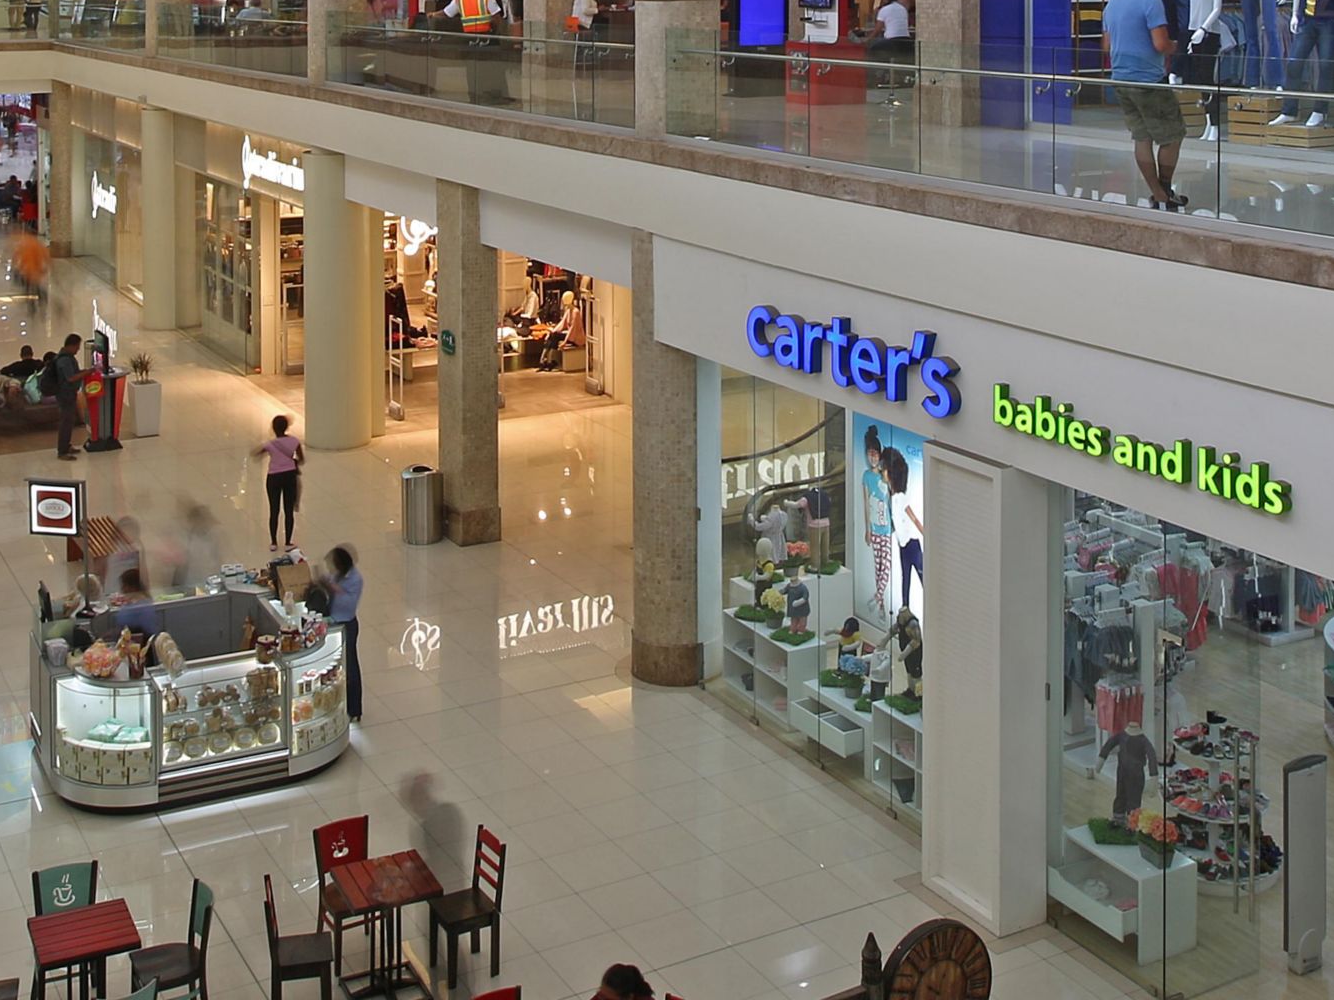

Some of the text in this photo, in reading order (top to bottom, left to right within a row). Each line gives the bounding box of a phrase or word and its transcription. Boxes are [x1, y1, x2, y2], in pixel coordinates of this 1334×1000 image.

[747, 304, 963, 420] carter's
[993, 383, 1293, 516] babies and kids
